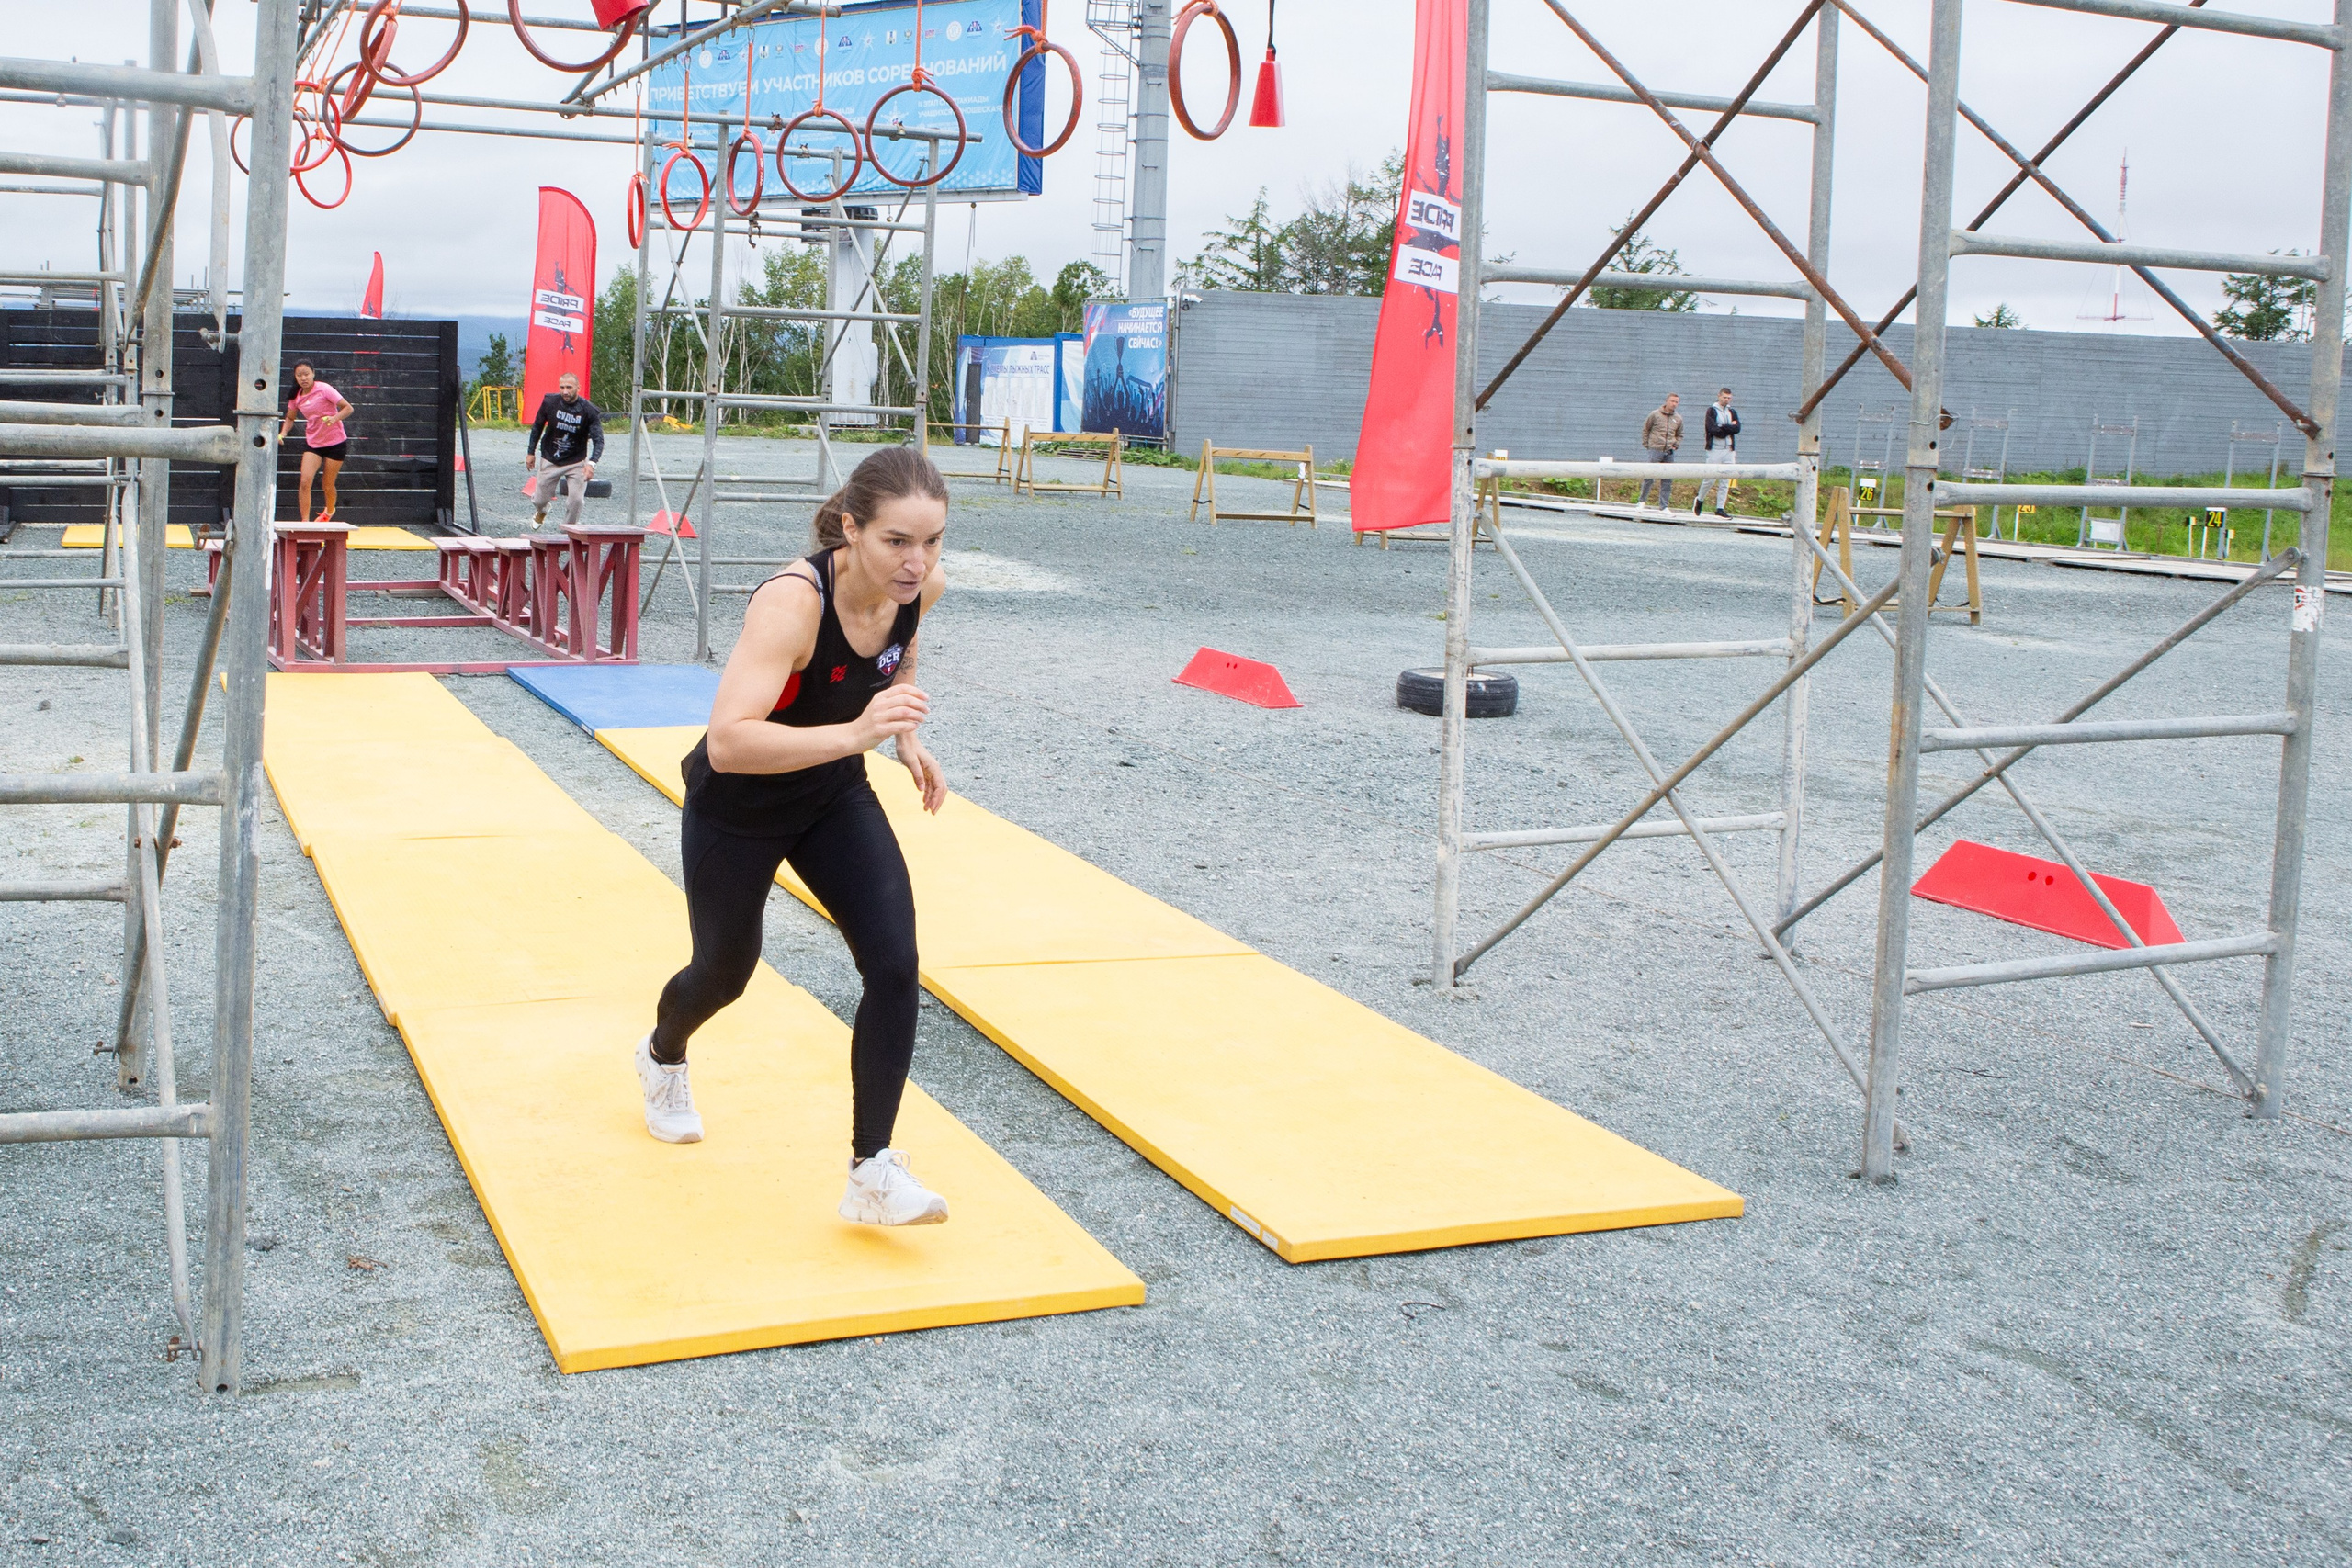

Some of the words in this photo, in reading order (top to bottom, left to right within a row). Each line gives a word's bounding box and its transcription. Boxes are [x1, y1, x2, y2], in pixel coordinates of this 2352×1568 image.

[649, 80, 759, 102] ПРИВЕТСТВУЕМ
[763, 69, 865, 94] УЧАСТНИКОВ
[867, 50, 1007, 84] СОРЕНОВАНИЙ
[939, 96, 989, 107] СТАКИАДЫ
[1128, 306, 1164, 320] «БУДУЩЕЕ
[1117, 321, 1163, 333] НАЧИНАЕТСЯ
[1128, 335, 1162, 349] СЕЙЧАС!»
[1034, 365, 1050, 374] ТРАСС
[556, 410, 582, 424] СУДЬЯ
[556, 422, 577, 433] JUDGE
[1860, 487, 1874, 501] 26
[2207, 511, 2222, 527] 24
